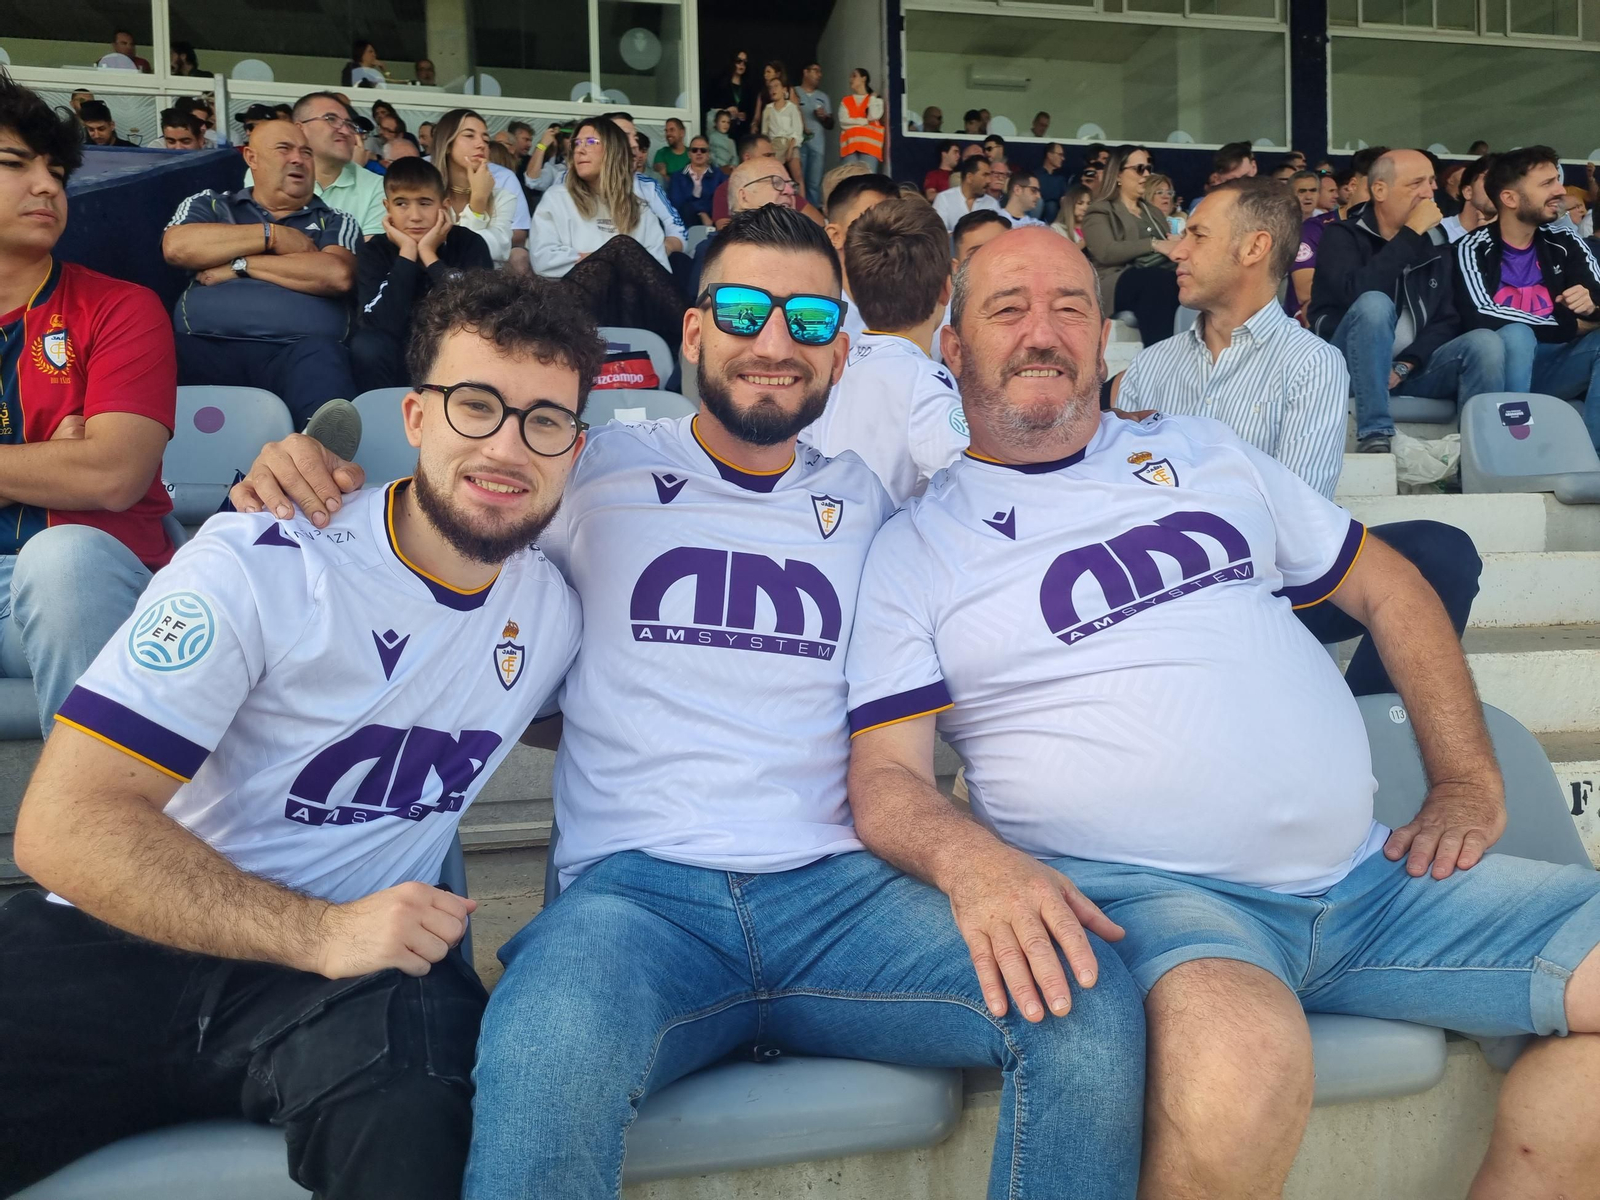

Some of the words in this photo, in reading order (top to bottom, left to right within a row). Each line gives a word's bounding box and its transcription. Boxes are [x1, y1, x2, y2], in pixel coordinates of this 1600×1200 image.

[1070, 565, 1251, 641] AMSYSTEM
[638, 627, 831, 658] AMSYSTEM
[1390, 709, 1405, 720] 113
[1570, 780, 1600, 817] F
